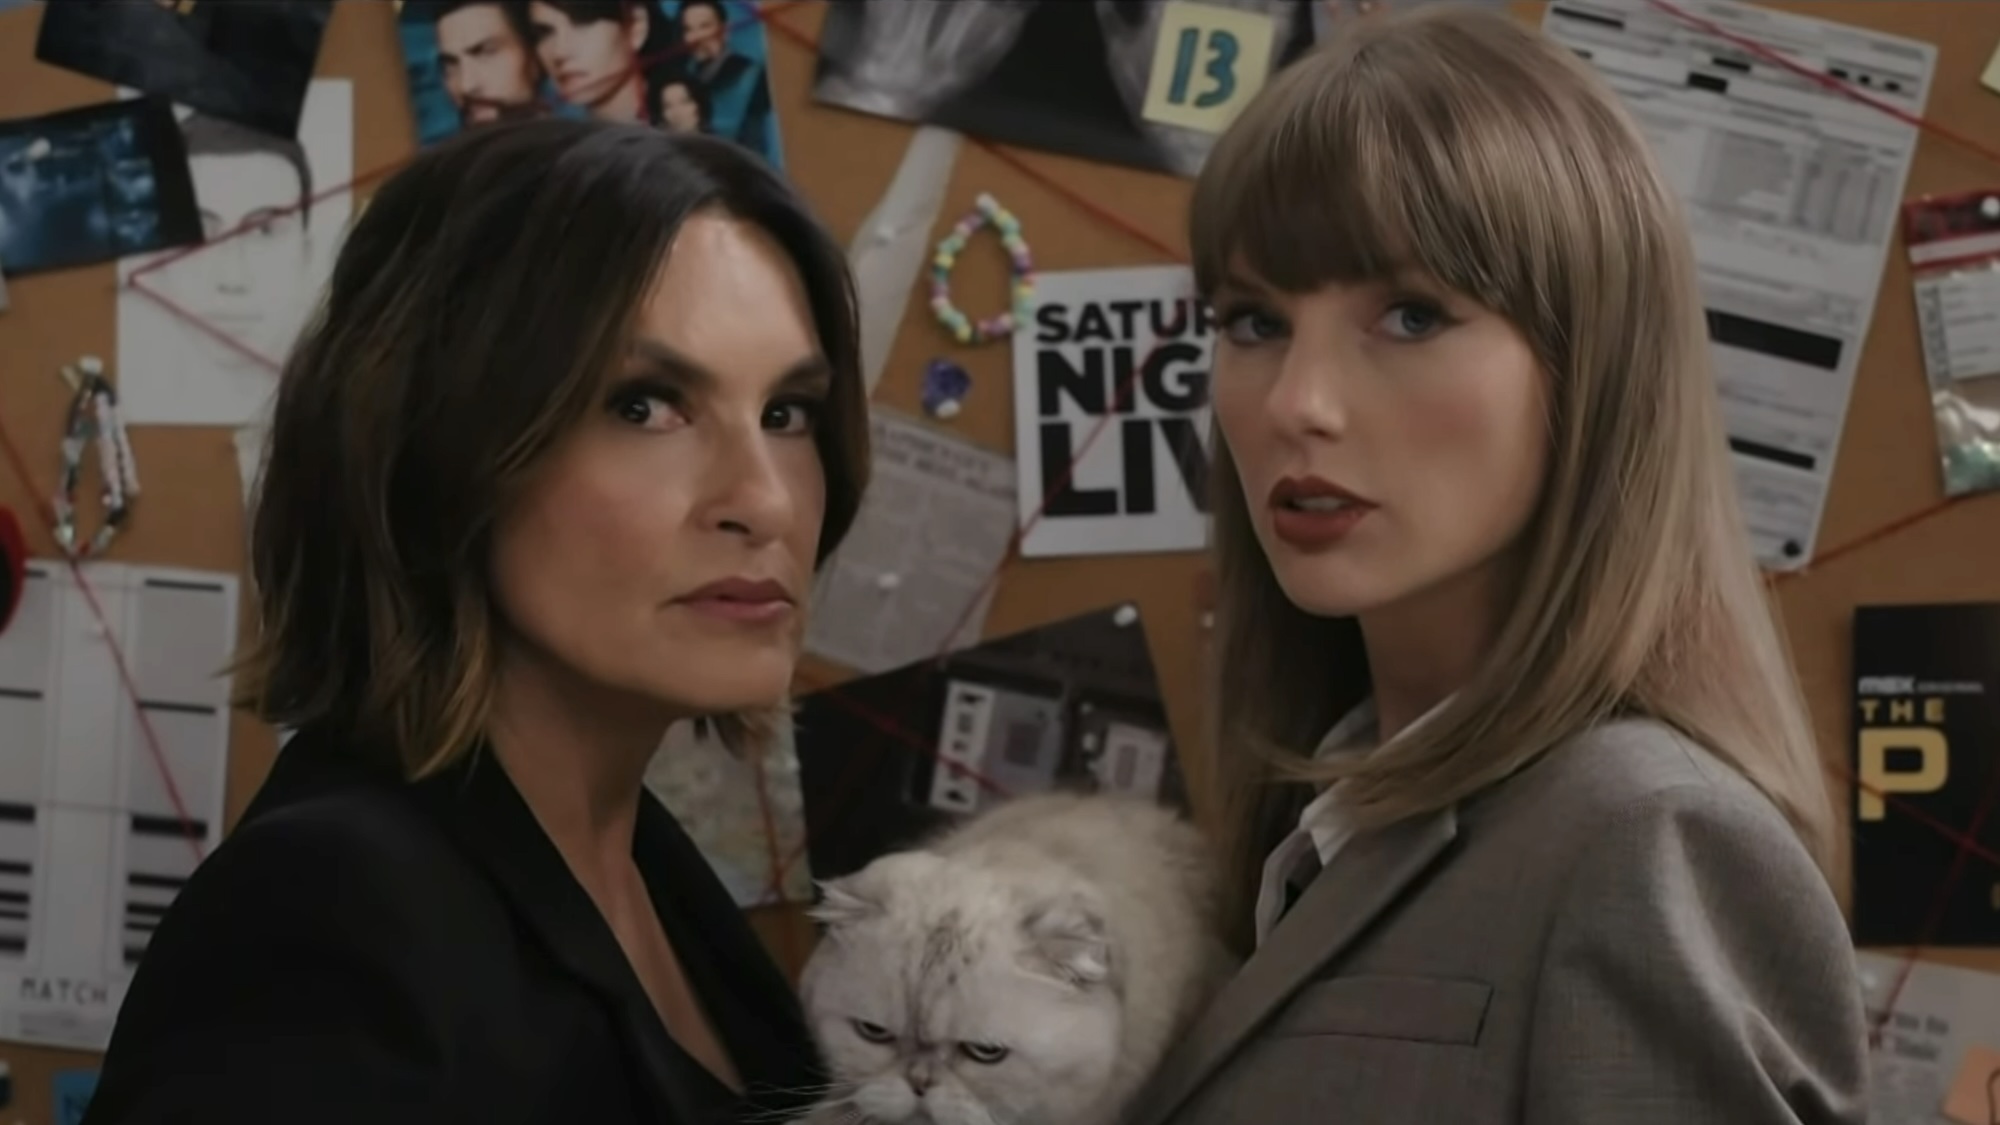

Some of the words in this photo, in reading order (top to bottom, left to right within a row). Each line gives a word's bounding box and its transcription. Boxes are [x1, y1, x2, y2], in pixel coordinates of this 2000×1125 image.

[1167, 27, 1240, 109] 13
[1037, 344, 1211, 416] NIG
[1858, 698, 1945, 723] THE
[1858, 727, 1949, 822] P
[20, 978, 108, 1006] MATCH
